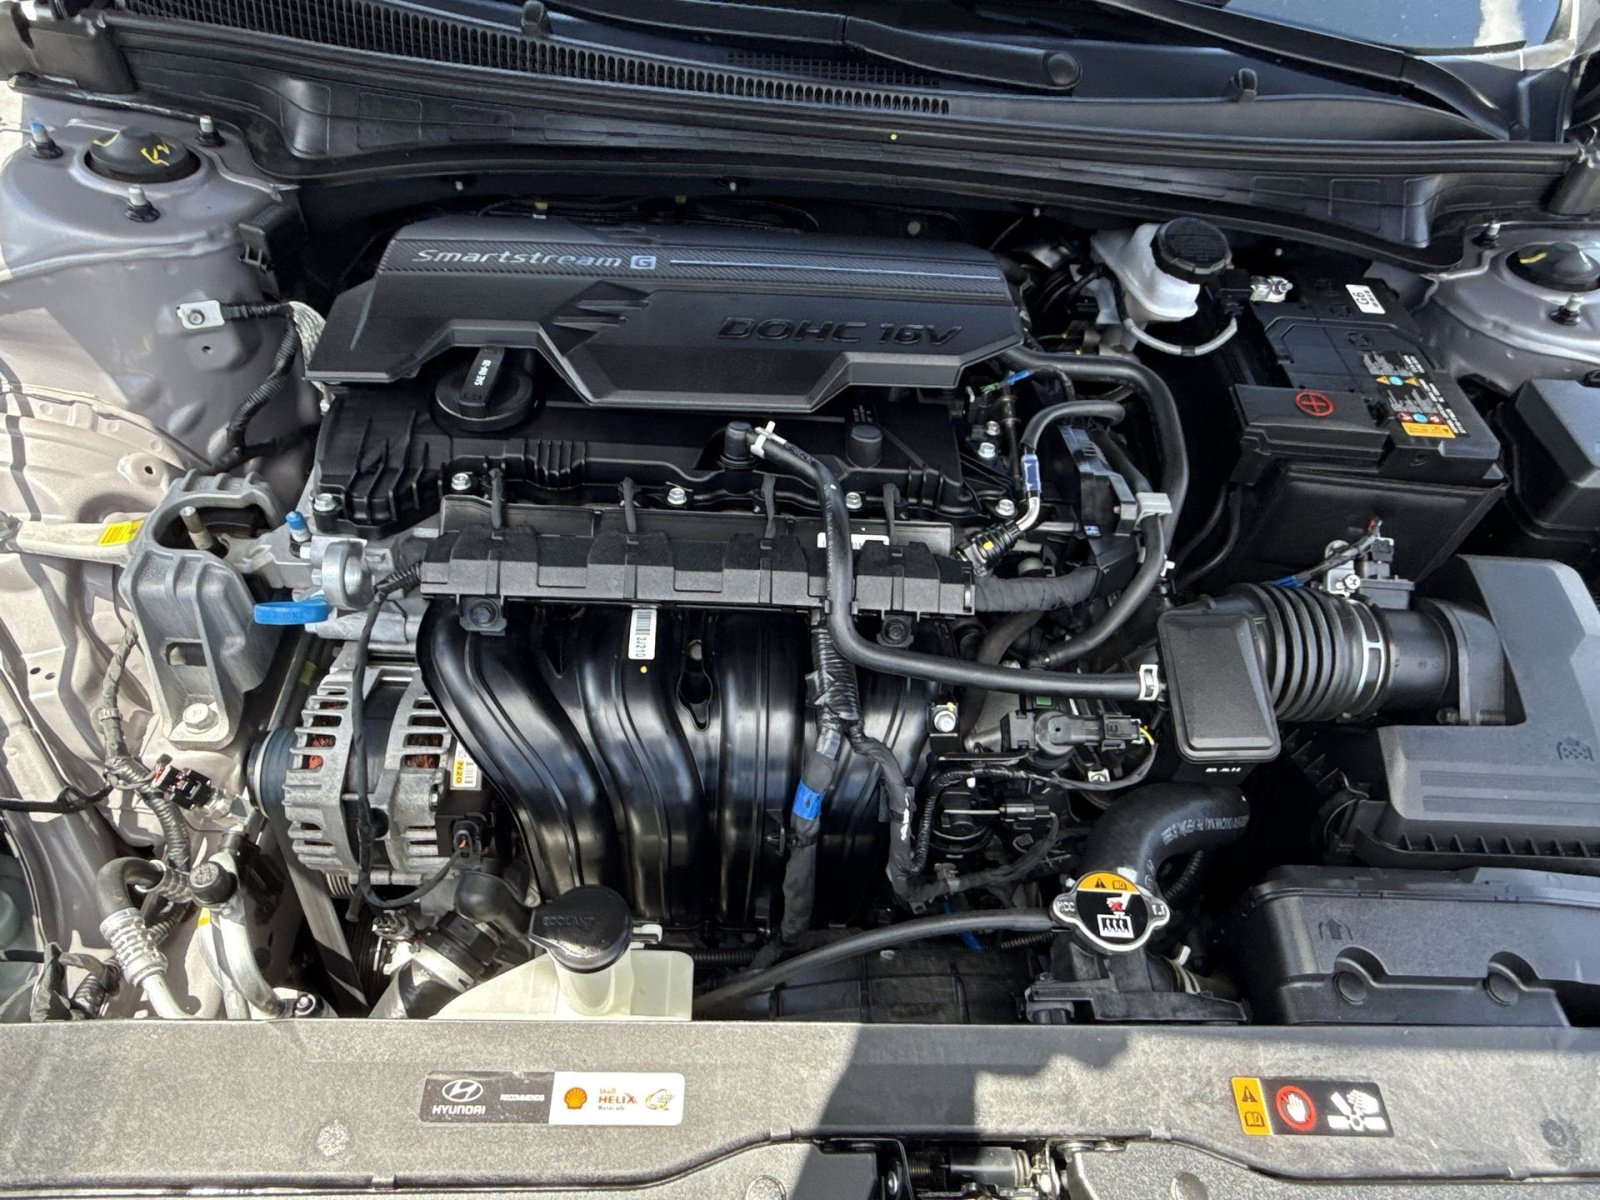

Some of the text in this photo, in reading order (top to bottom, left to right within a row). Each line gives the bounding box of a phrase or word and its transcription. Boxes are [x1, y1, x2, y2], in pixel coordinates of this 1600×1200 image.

[412, 250, 621, 267] Smartstream
[718, 317, 962, 346] DOHC 16V
[456, 761, 464, 784] N20
[598, 1092, 638, 1105] HELIX
[431, 1104, 486, 1115] HYUNDAI
